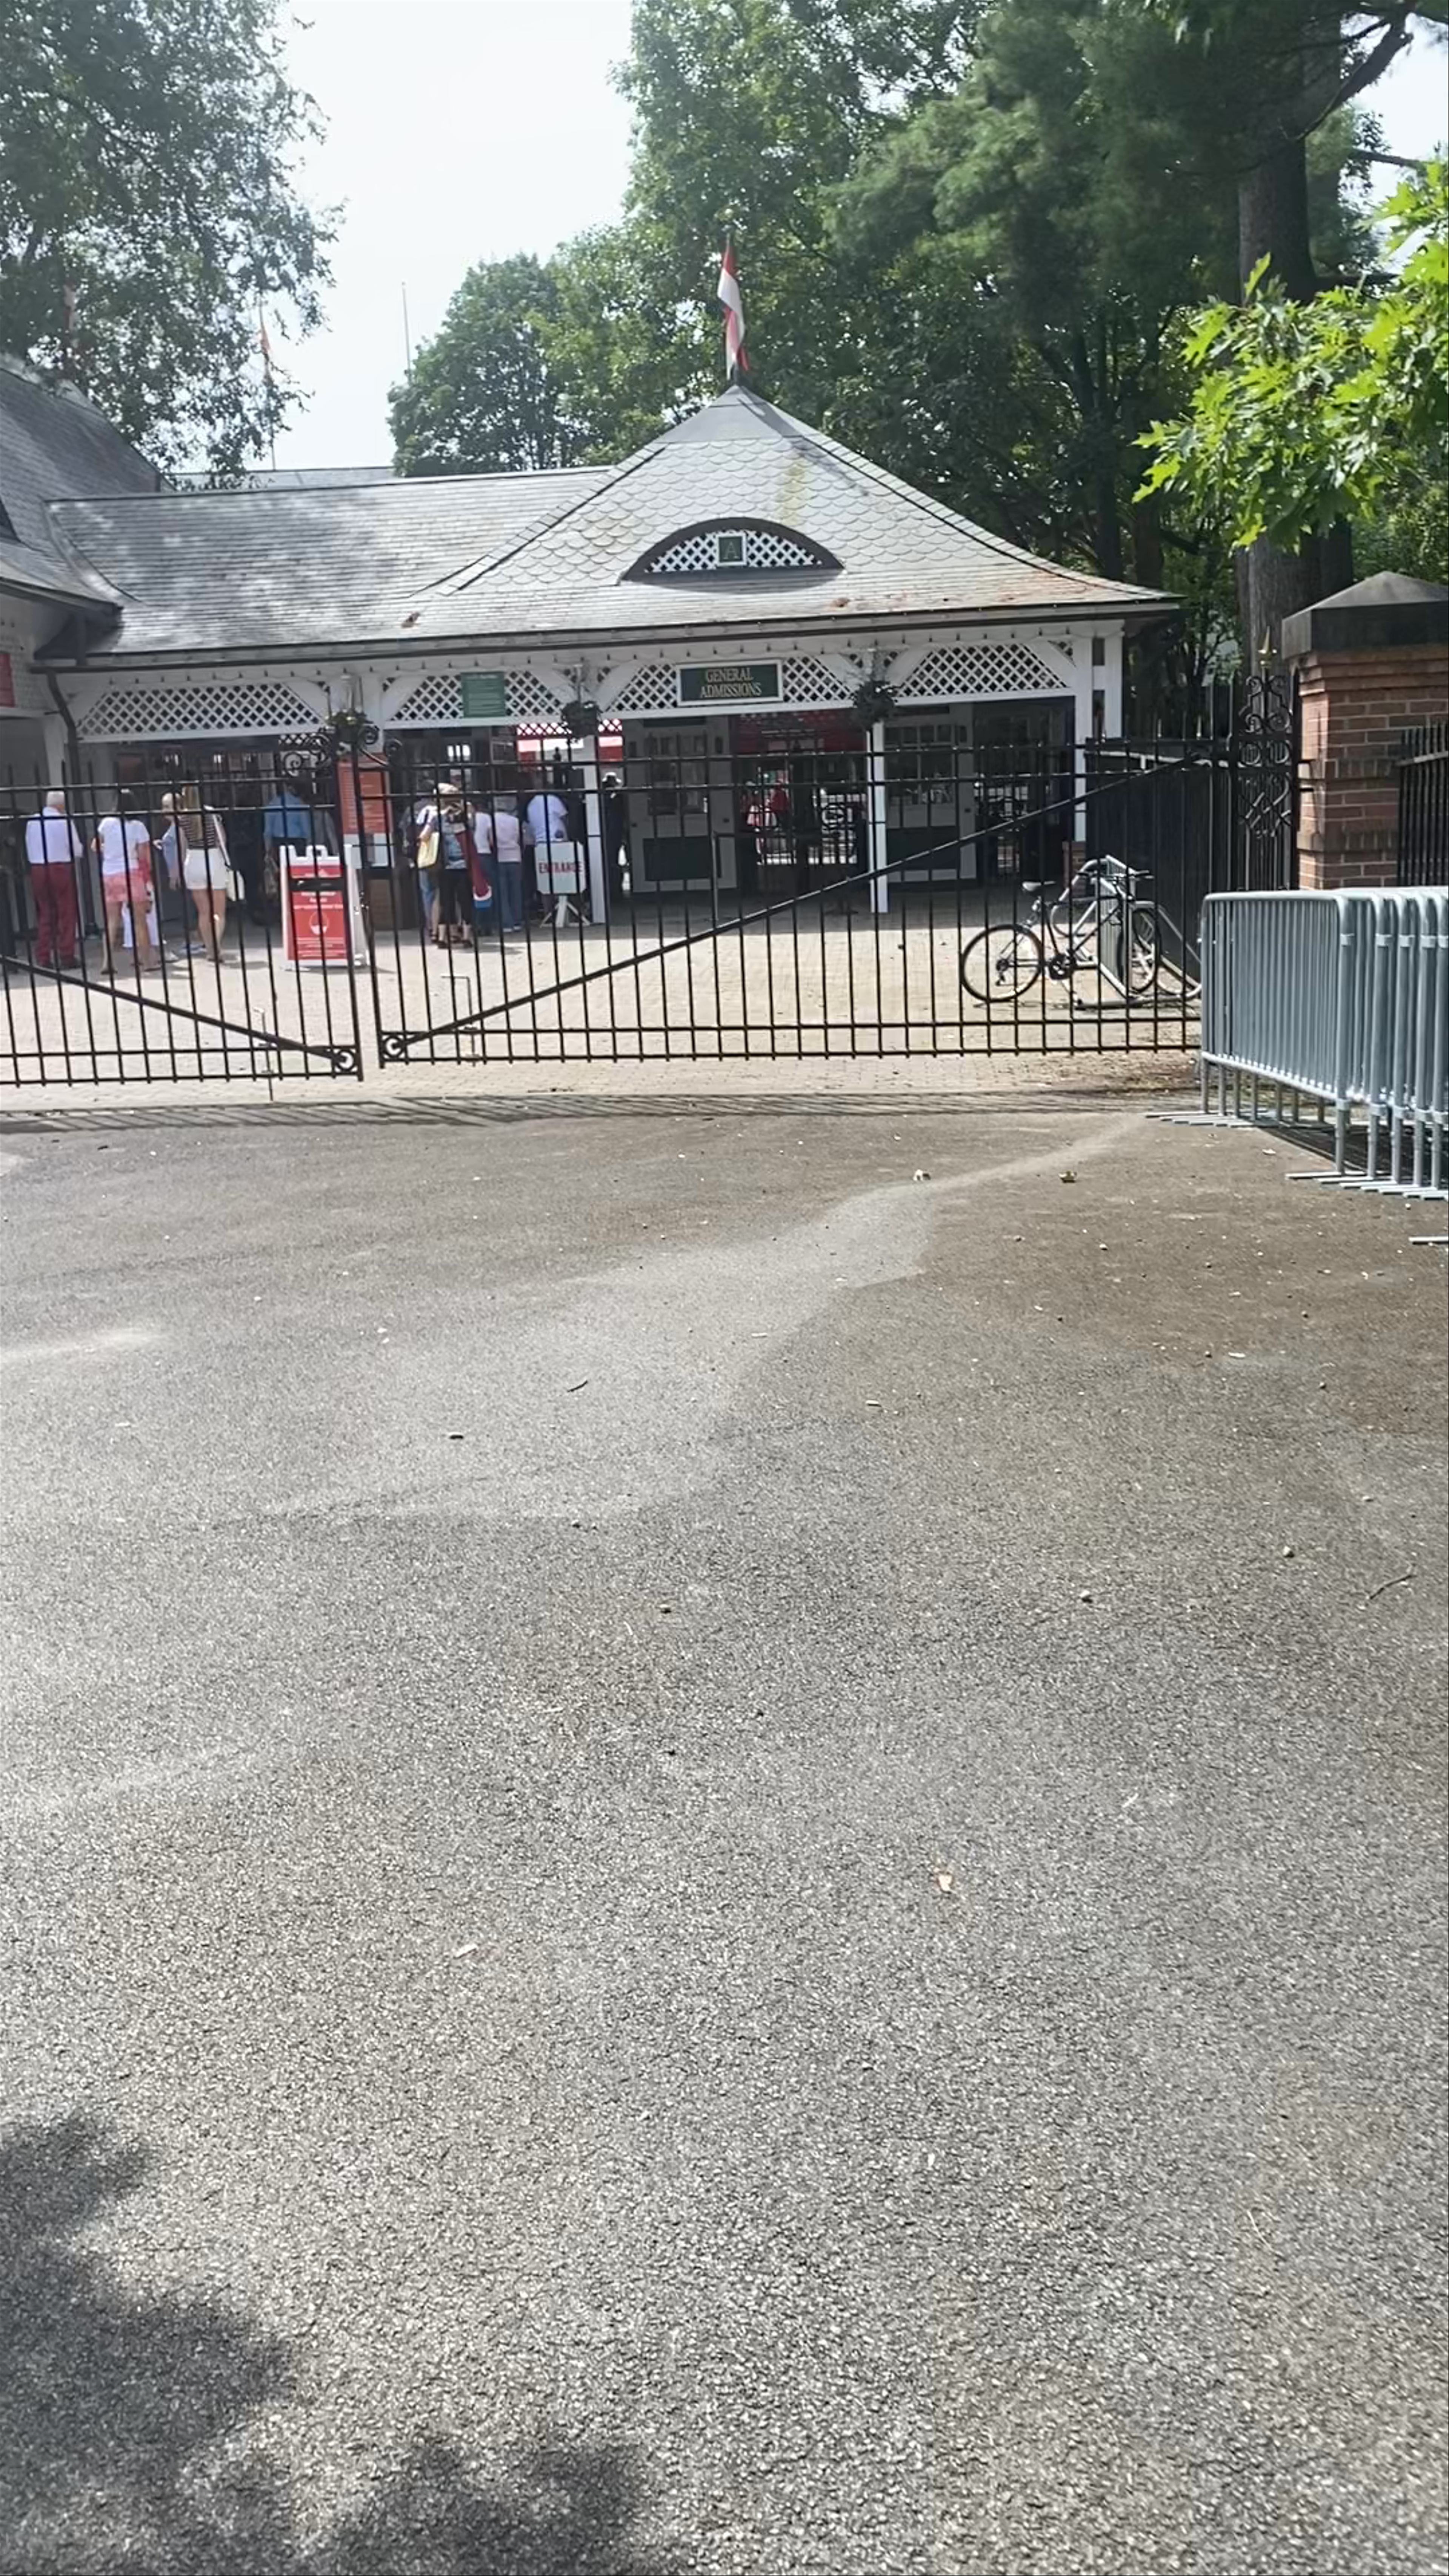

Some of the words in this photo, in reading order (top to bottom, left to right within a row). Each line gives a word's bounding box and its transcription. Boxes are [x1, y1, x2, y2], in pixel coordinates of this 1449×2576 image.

[723, 541, 739, 559] A
[706, 667, 754, 682] GENERAL
[700, 682, 762, 698] ADMISSIONS
